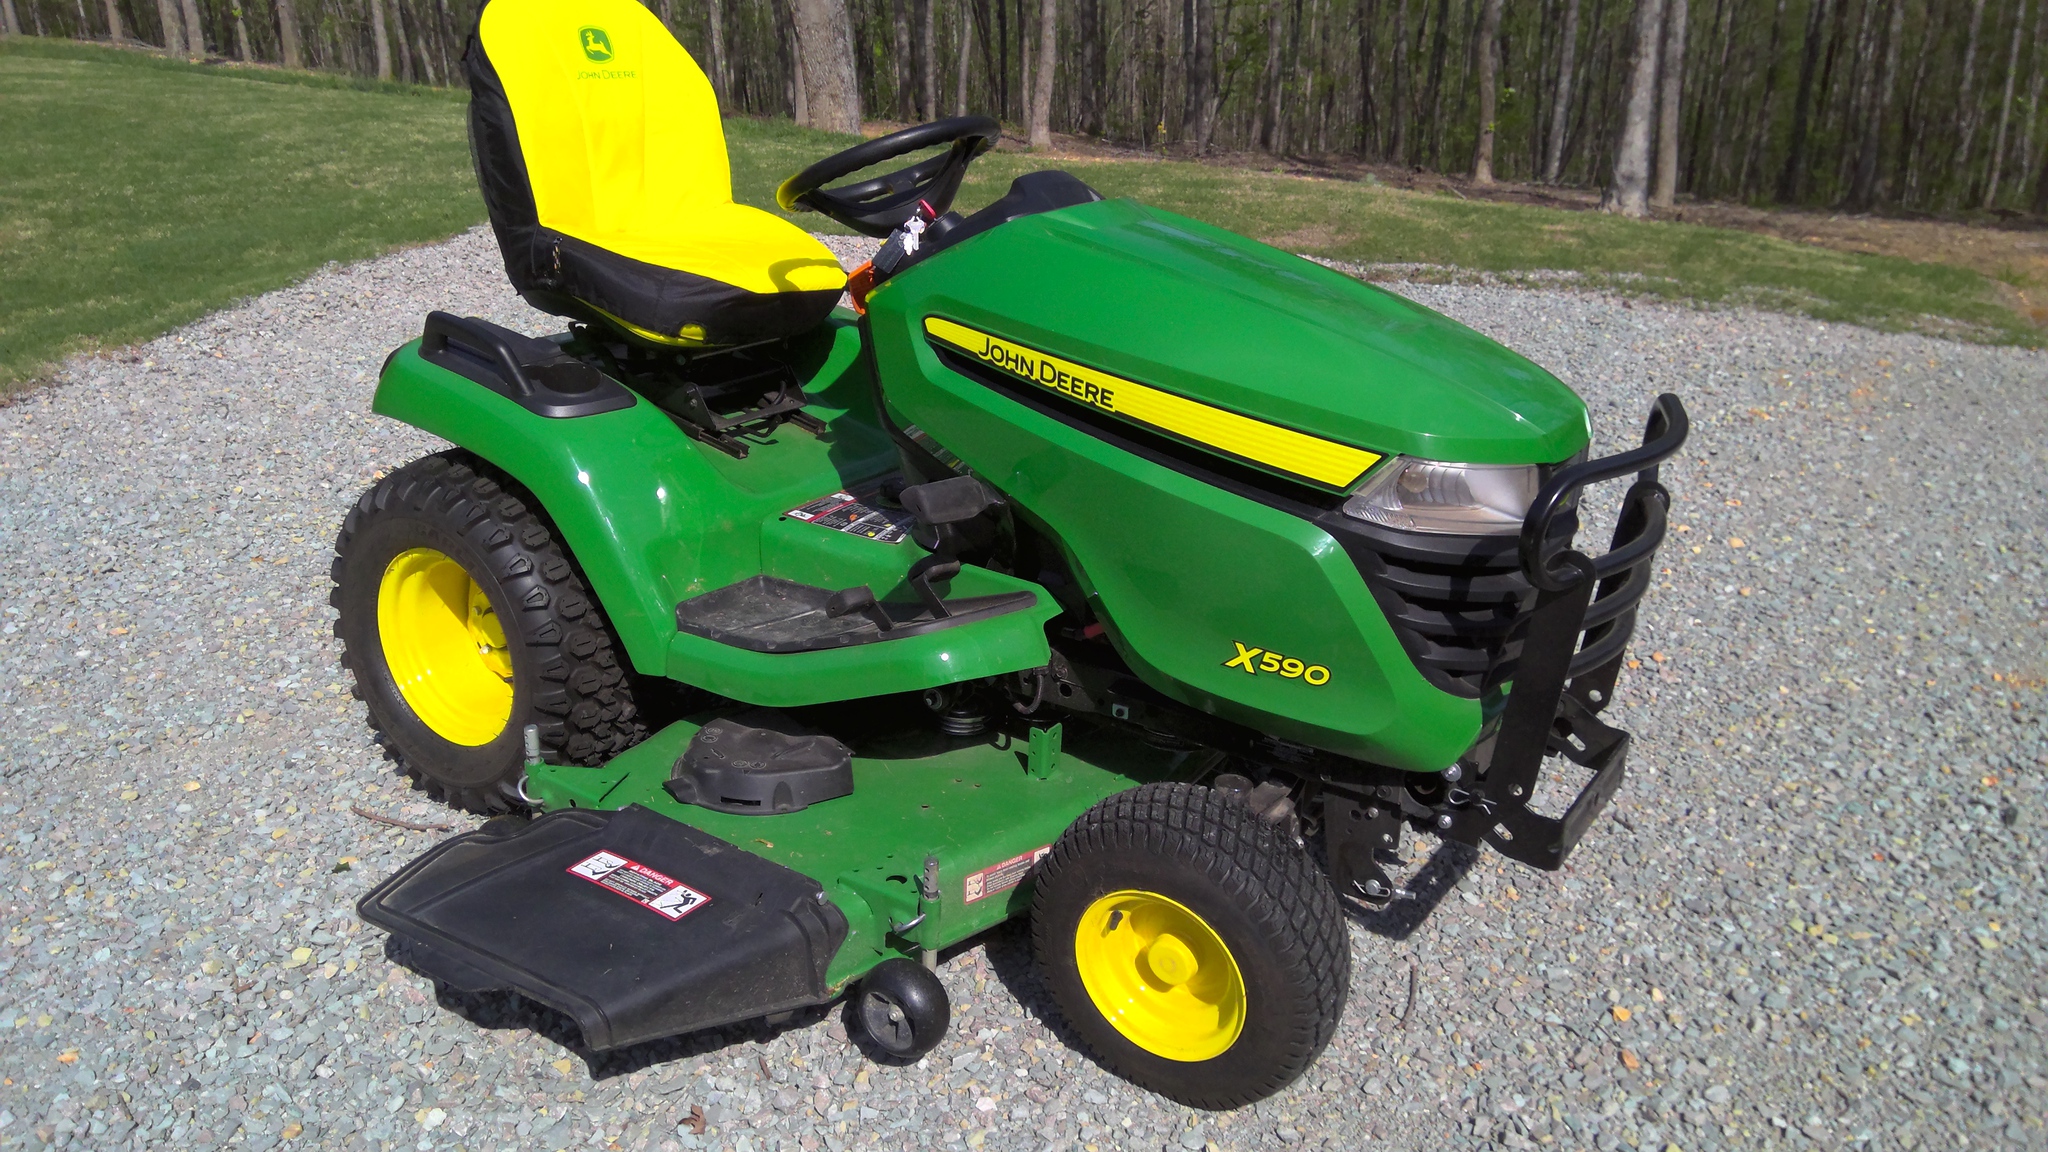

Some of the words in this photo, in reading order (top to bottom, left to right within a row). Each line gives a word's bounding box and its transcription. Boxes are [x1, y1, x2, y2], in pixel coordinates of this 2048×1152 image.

[577, 70, 601, 80] JOHN
[602, 70, 637, 80] DEERE
[978, 337, 1034, 377] JOHN
[1040, 360, 1115, 409] DEERE
[1222, 640, 1331, 686] X590
[1002, 855, 1023, 868] DANGER
[639, 866, 674, 885] DANGER
